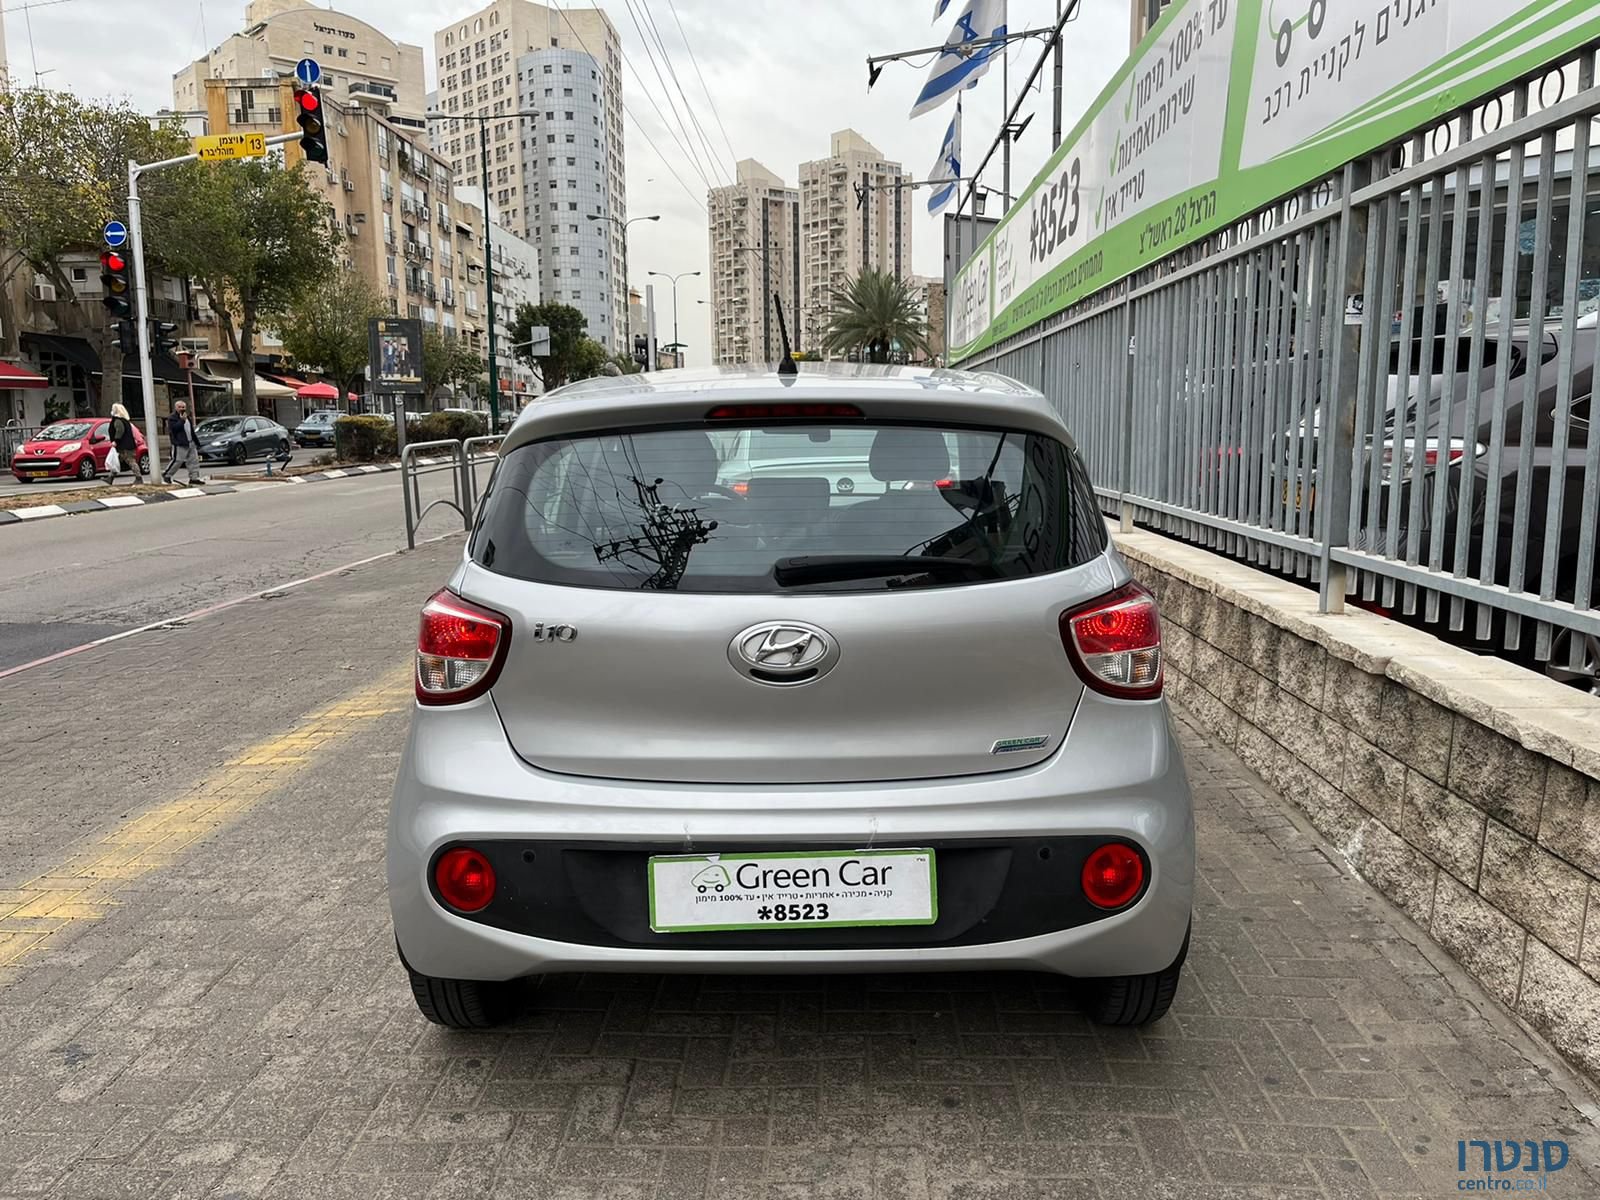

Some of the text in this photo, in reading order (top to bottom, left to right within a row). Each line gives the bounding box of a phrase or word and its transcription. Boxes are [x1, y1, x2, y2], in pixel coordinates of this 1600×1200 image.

[1168, 10, 1203, 78] 100%
[1298, 19, 1367, 100] לקניית
[1135, 57, 1165, 122] מימון
[1262, 80, 1292, 125] רכב
[1117, 74, 1196, 174] שירות ואמינות
[218, 136, 239, 147] ויצמן
[249, 138, 262, 150] 13
[205, 146, 235, 157] מוהליבר
[1104, 168, 1146, 233] טרייד אין
[1189, 190, 1217, 228] הרצל
[1174, 202, 1187, 236] 28
[534, 621, 578, 643] i10
[736, 859, 893, 890] Green Car
[695, 895, 717, 904] מימון
[719, 894, 743, 902] 100%
[761, 893, 774, 903] אין
[777, 893, 799, 901] טרייד
[804, 892, 835, 900] אחריות
[841, 891, 867, 899] מכירה
[873, 889, 893, 899] קניה
